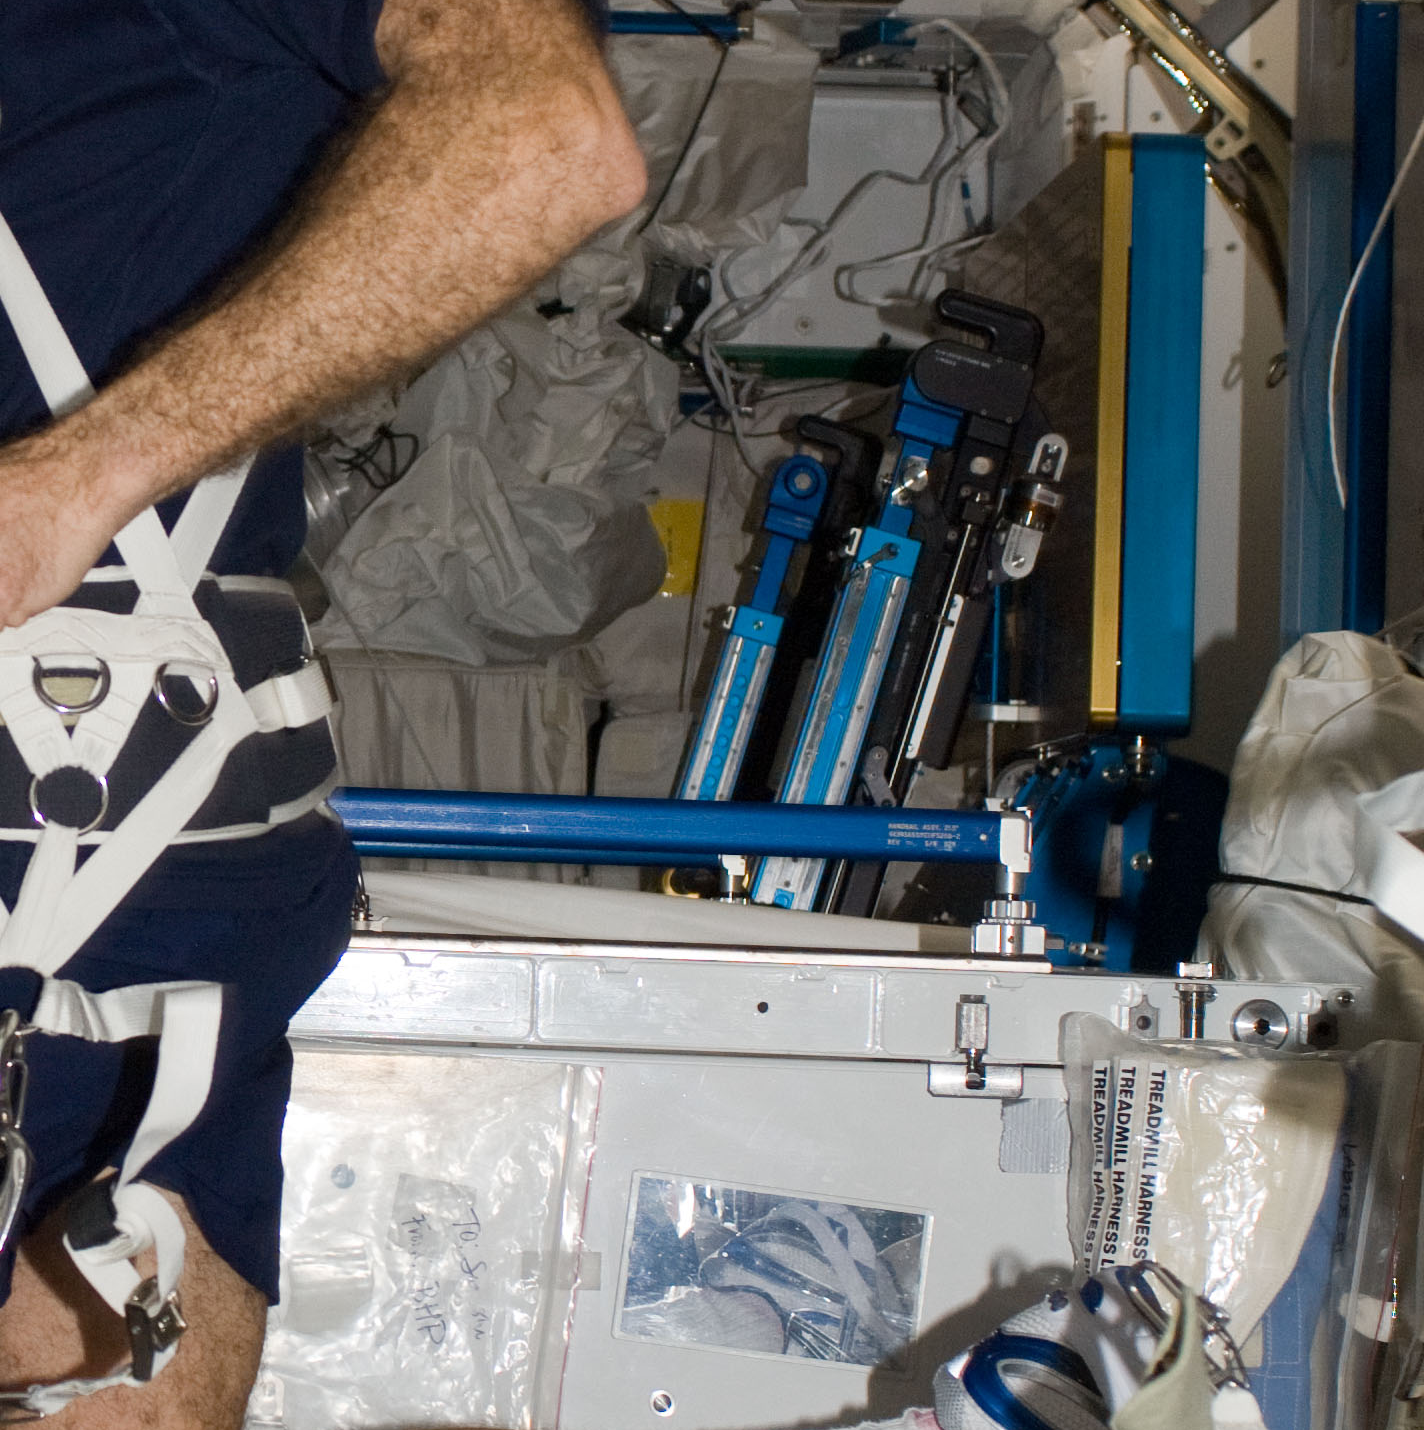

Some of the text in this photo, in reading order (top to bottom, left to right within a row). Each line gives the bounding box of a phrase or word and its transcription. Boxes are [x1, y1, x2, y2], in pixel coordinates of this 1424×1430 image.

[1093, 1066, 1108, 1166] TREADMILL
[1113, 1066, 1137, 1166] TREADMILL
[1132, 1069, 1167, 1260] TREADMILL HARNESS
[1083, 1171, 1105, 1254] HARNESS
[1103, 1170, 1126, 1255] HARNESS
[412, 1281, 447, 1345] BHP
